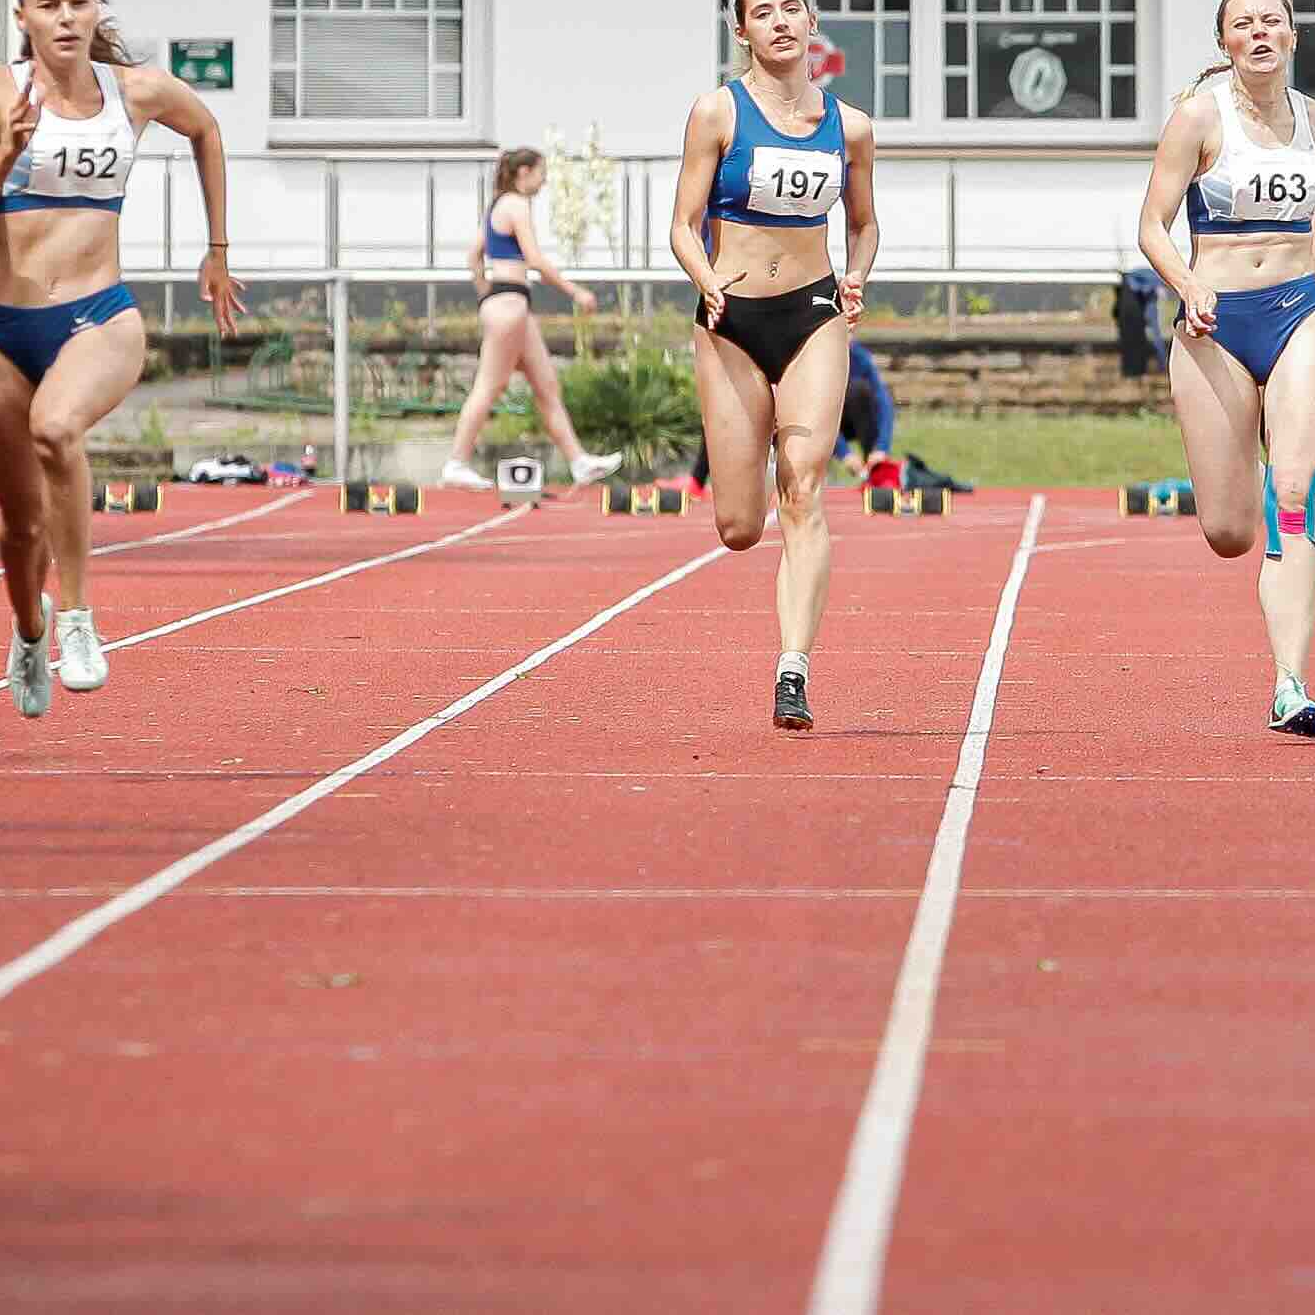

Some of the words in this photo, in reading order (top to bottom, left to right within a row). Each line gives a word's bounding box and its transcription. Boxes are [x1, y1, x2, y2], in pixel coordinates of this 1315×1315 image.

[53, 145, 118, 179] 152
[771, 167, 830, 201] 197
[1248, 172, 1307, 203] 163
